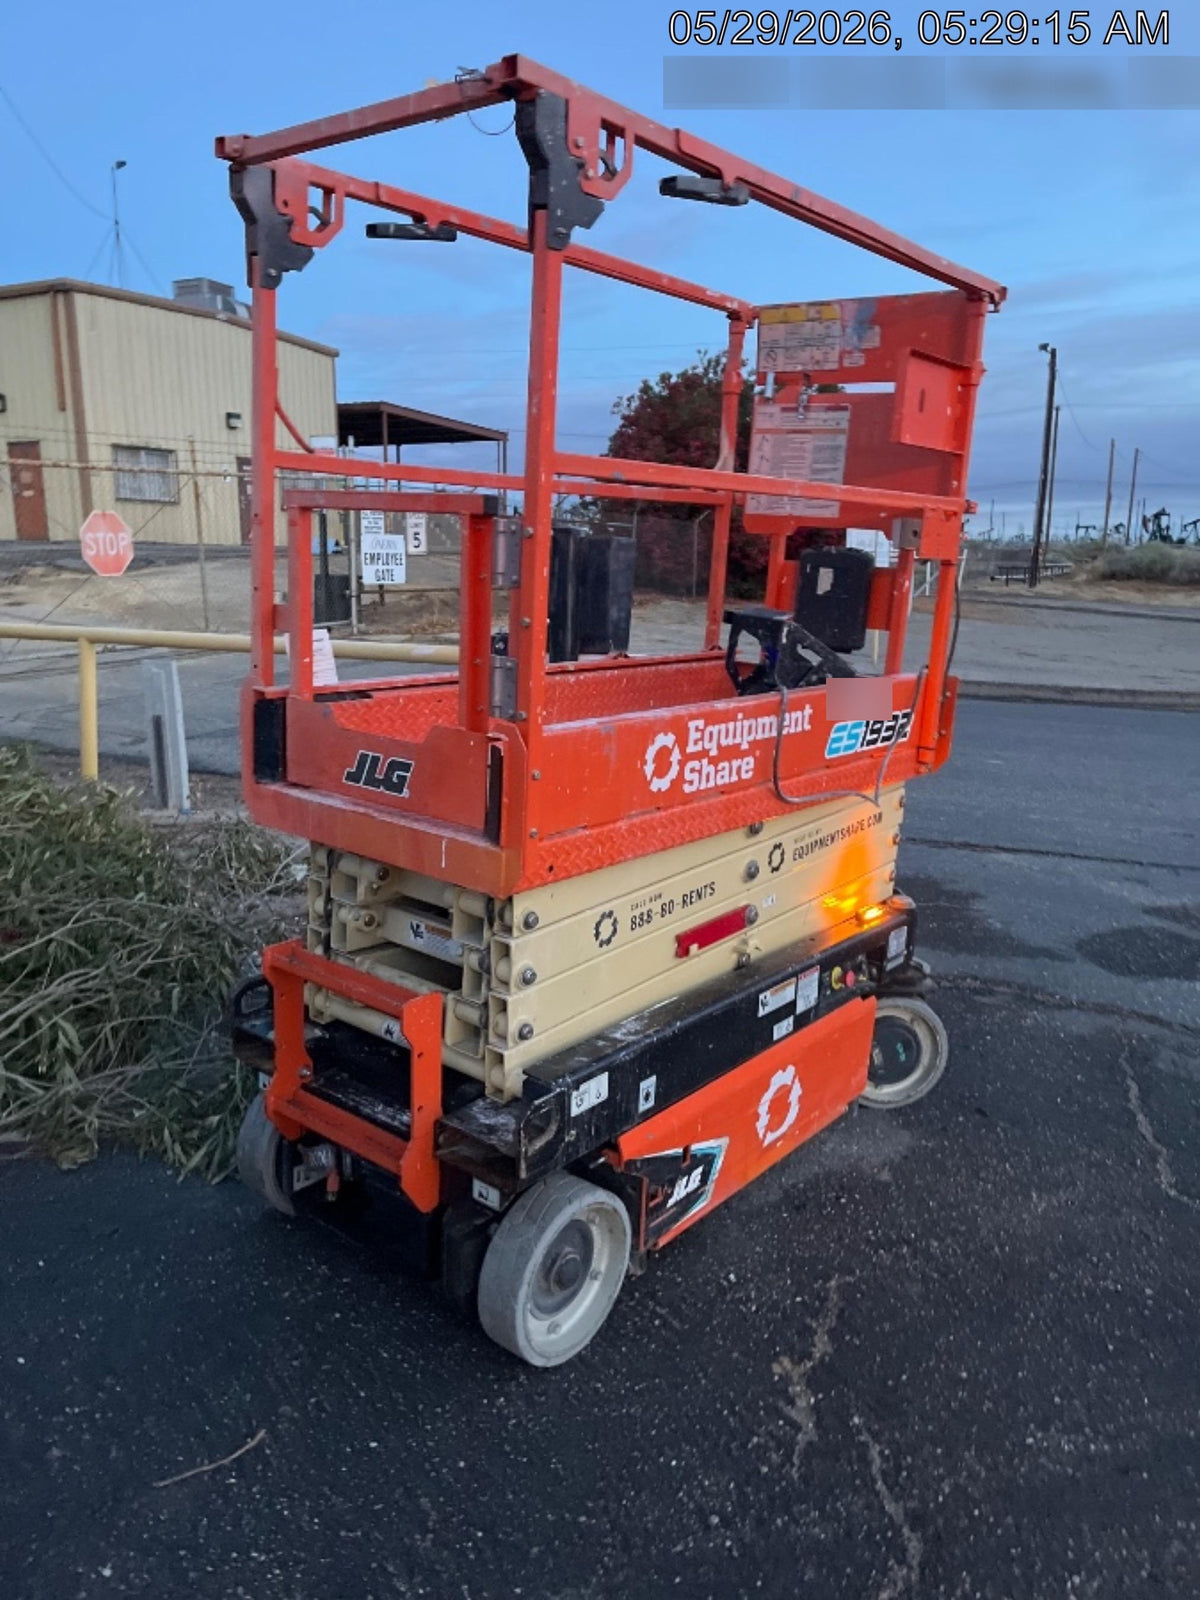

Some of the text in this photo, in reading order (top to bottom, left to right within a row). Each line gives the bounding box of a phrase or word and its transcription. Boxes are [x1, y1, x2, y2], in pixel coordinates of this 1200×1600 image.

[85, 532, 129, 557] STOP
[413, 532, 422, 548] 5
[363, 552, 403, 566] EMPLOYEE
[375, 569, 395, 582] GATE
[686, 704, 813, 757] Equipment
[342, 749, 414, 798] JLG
[683, 755, 755, 793] Share
